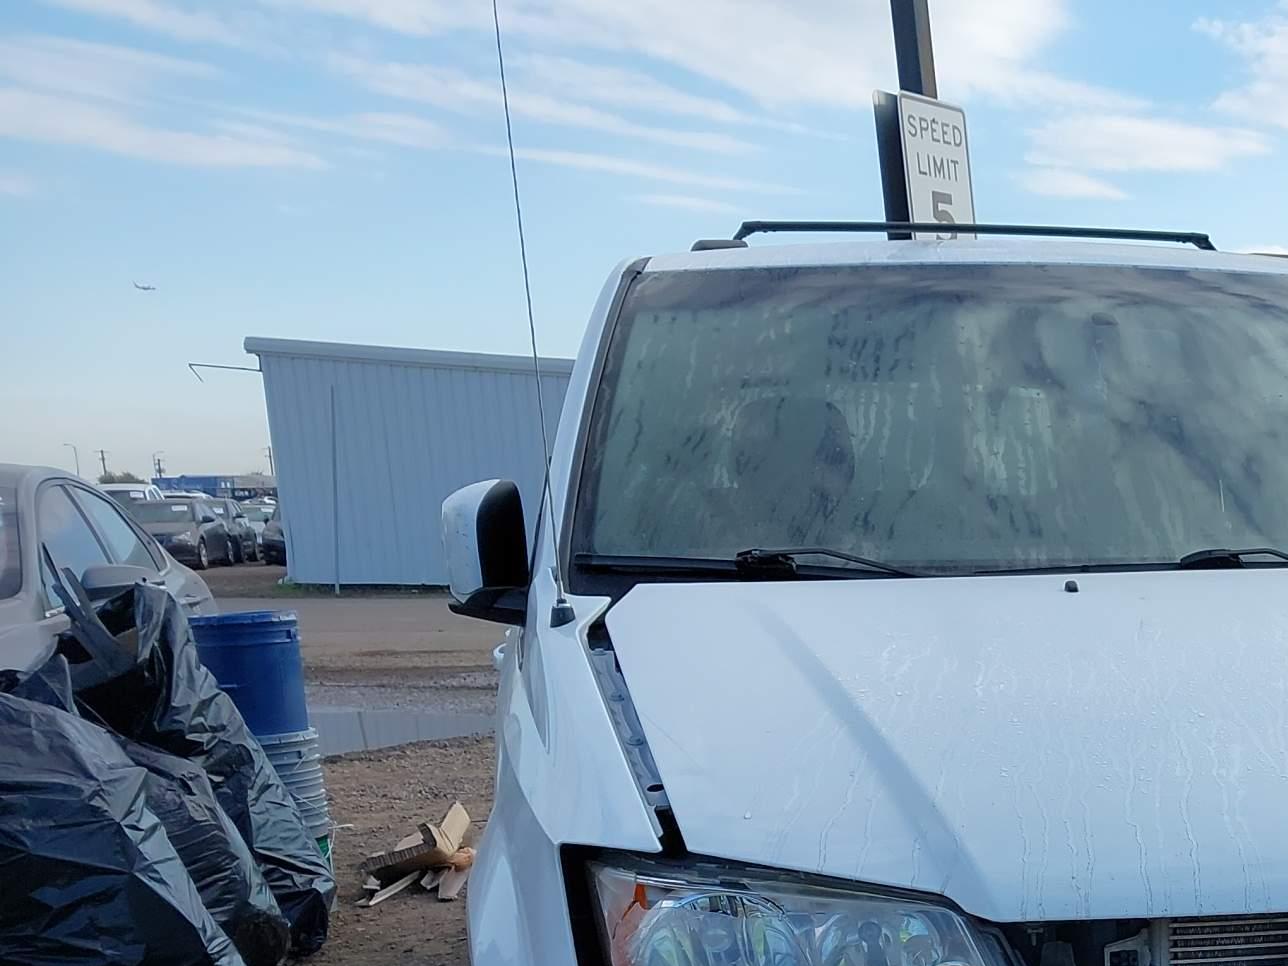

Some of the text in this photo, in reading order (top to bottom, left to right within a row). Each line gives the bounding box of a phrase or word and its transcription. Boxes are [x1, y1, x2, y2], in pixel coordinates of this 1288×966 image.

[907, 115, 962, 146] SPEED
[916, 152, 959, 181] LIMIT
[931, 190, 958, 240] 5
